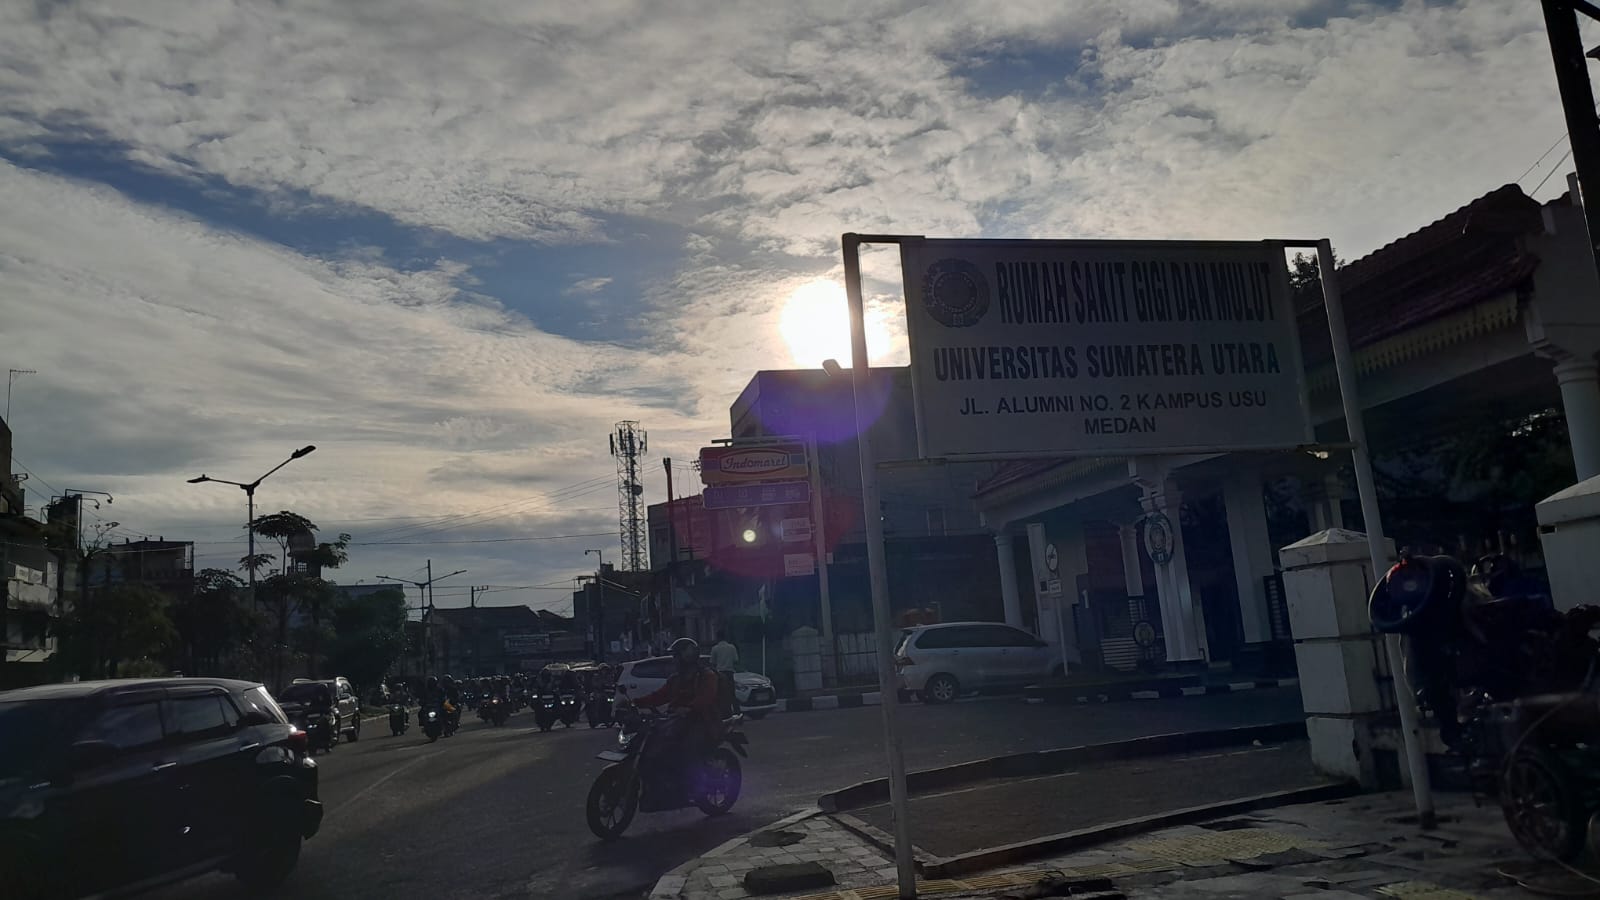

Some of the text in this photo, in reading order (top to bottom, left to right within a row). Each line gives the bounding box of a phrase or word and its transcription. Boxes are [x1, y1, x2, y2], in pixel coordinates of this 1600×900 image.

[995, 262, 1070, 324] RUMAH
[1070, 261, 1128, 324] SAKIT
[1131, 261, 1172, 322] GIGI
[1170, 262, 1212, 321] DAN
[1210, 262, 1274, 322] MULUT
[933, 342, 1280, 381] UNIVERSITAS SUMATERA UTARA
[960, 391, 1266, 415] JL. ALUMNI NO. 2 KAMPUS USU
[1085, 416, 1156, 434] MEDAN
[723, 454, 787, 470] Indomaret
